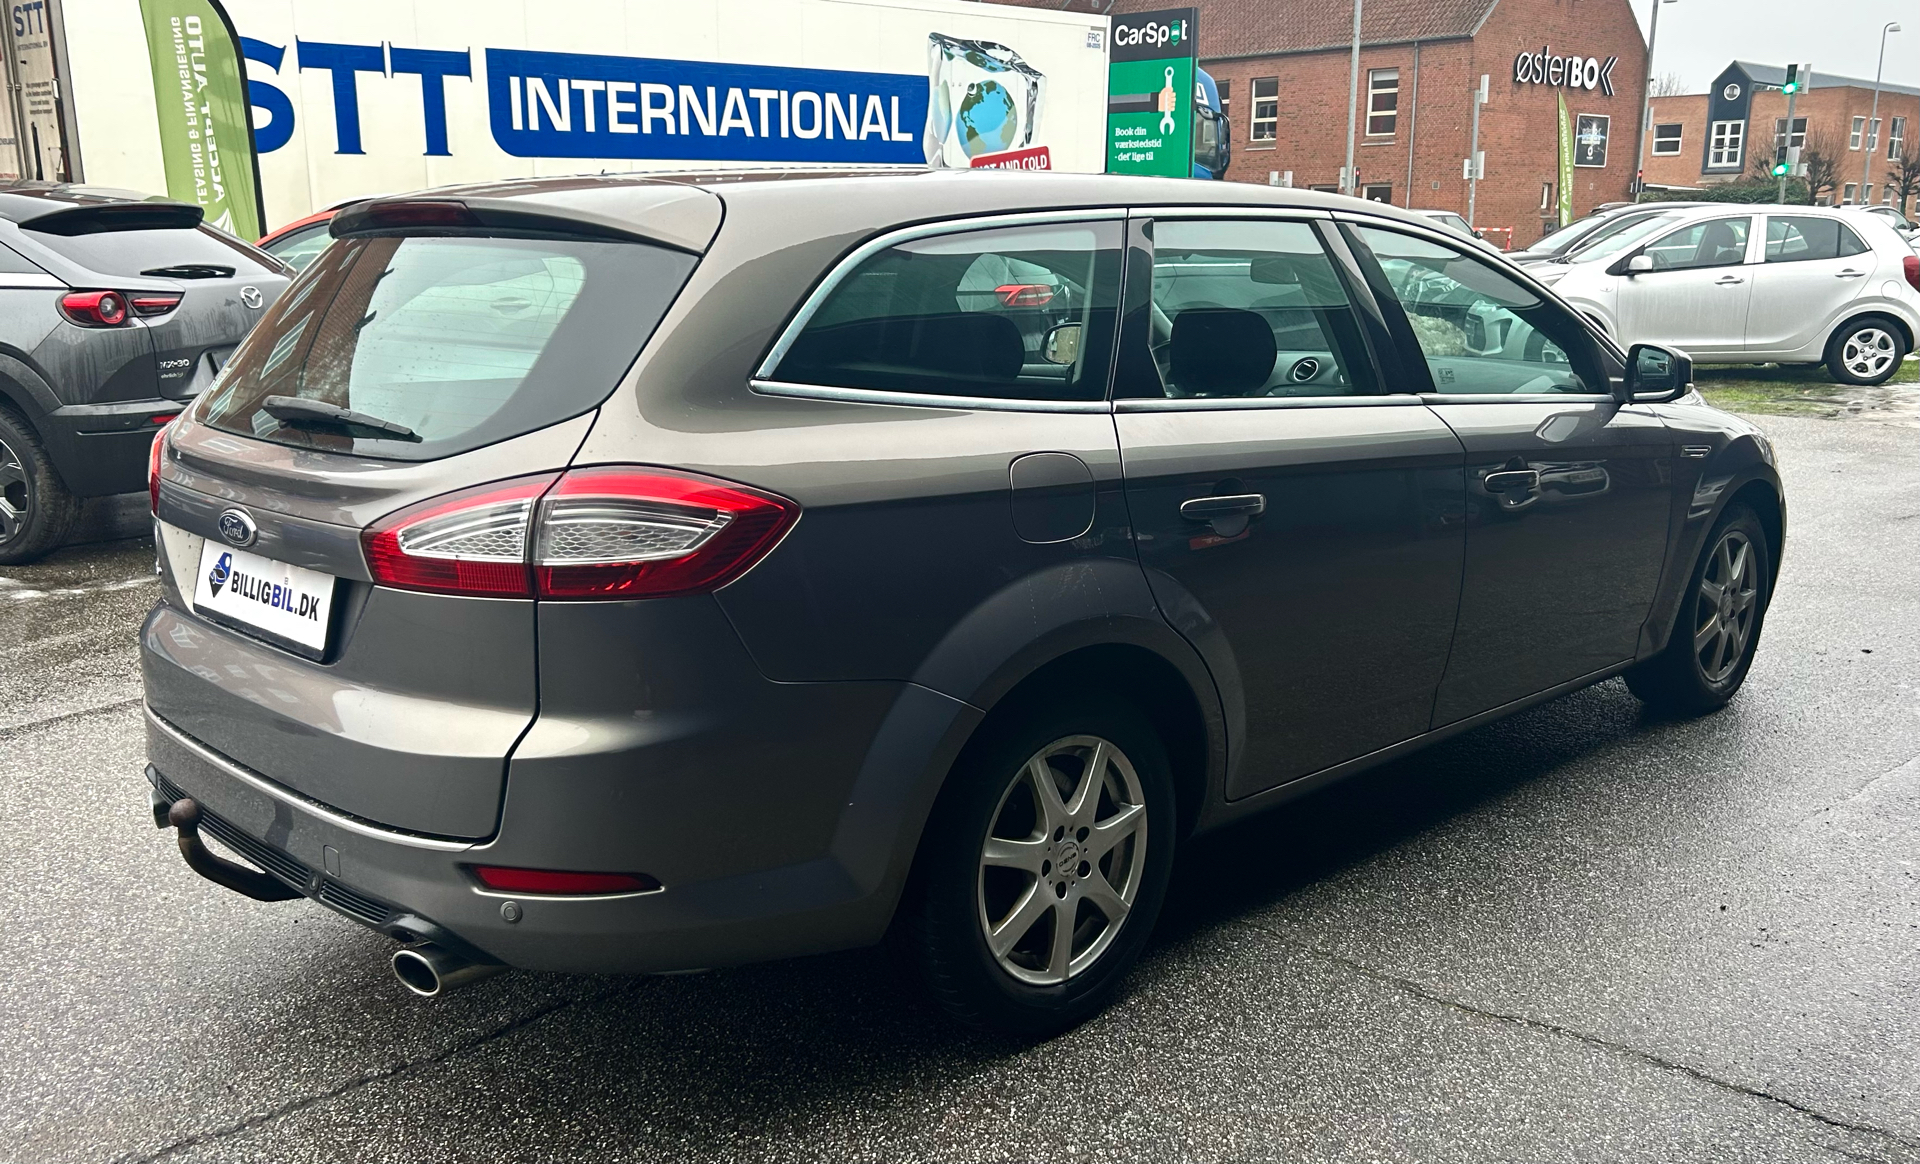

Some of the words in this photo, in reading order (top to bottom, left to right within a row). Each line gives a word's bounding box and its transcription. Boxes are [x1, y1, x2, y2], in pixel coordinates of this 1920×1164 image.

[13, 1, 44, 37] STT
[1087, 32, 1101, 42] FRC
[1115, 20, 1188, 48] CarSpot
[238, 35, 473, 156] STT
[509, 76, 914, 142] INTERNATIONAL
[1115, 128, 1133, 136] Book
[1134, 127, 1147, 135] din
[1115, 139, 1162, 148] værkstedstid
[1022, 155, 1047, 171] COLD
[1132, 152, 1145, 162] lige
[1145, 152, 1154, 160] til
[160, 358, 190, 369] MX-30
[223, 516, 245, 539] Ford
[231, 570, 320, 622] BILLIGBIL.DK
